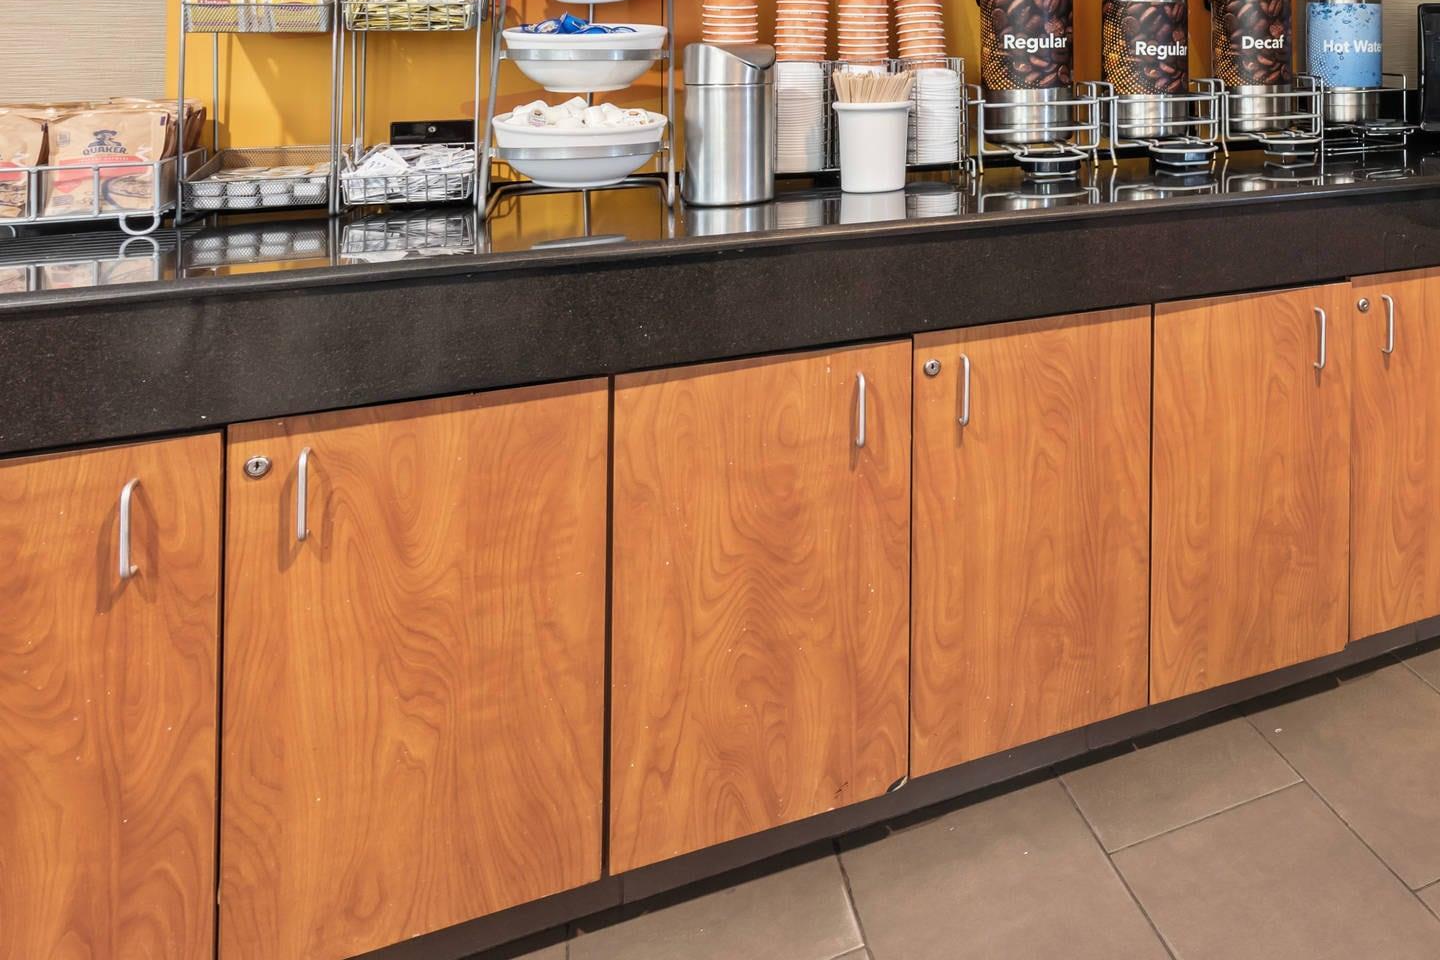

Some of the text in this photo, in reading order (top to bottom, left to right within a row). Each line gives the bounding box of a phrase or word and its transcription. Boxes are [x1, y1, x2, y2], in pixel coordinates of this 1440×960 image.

[1003, 32, 1068, 53] Regular
[1242, 34, 1285, 50] Decaf
[1323, 40, 1349, 54] Hot
[1136, 41, 1188, 60] Regular
[82, 146, 127, 156] QUAKER
